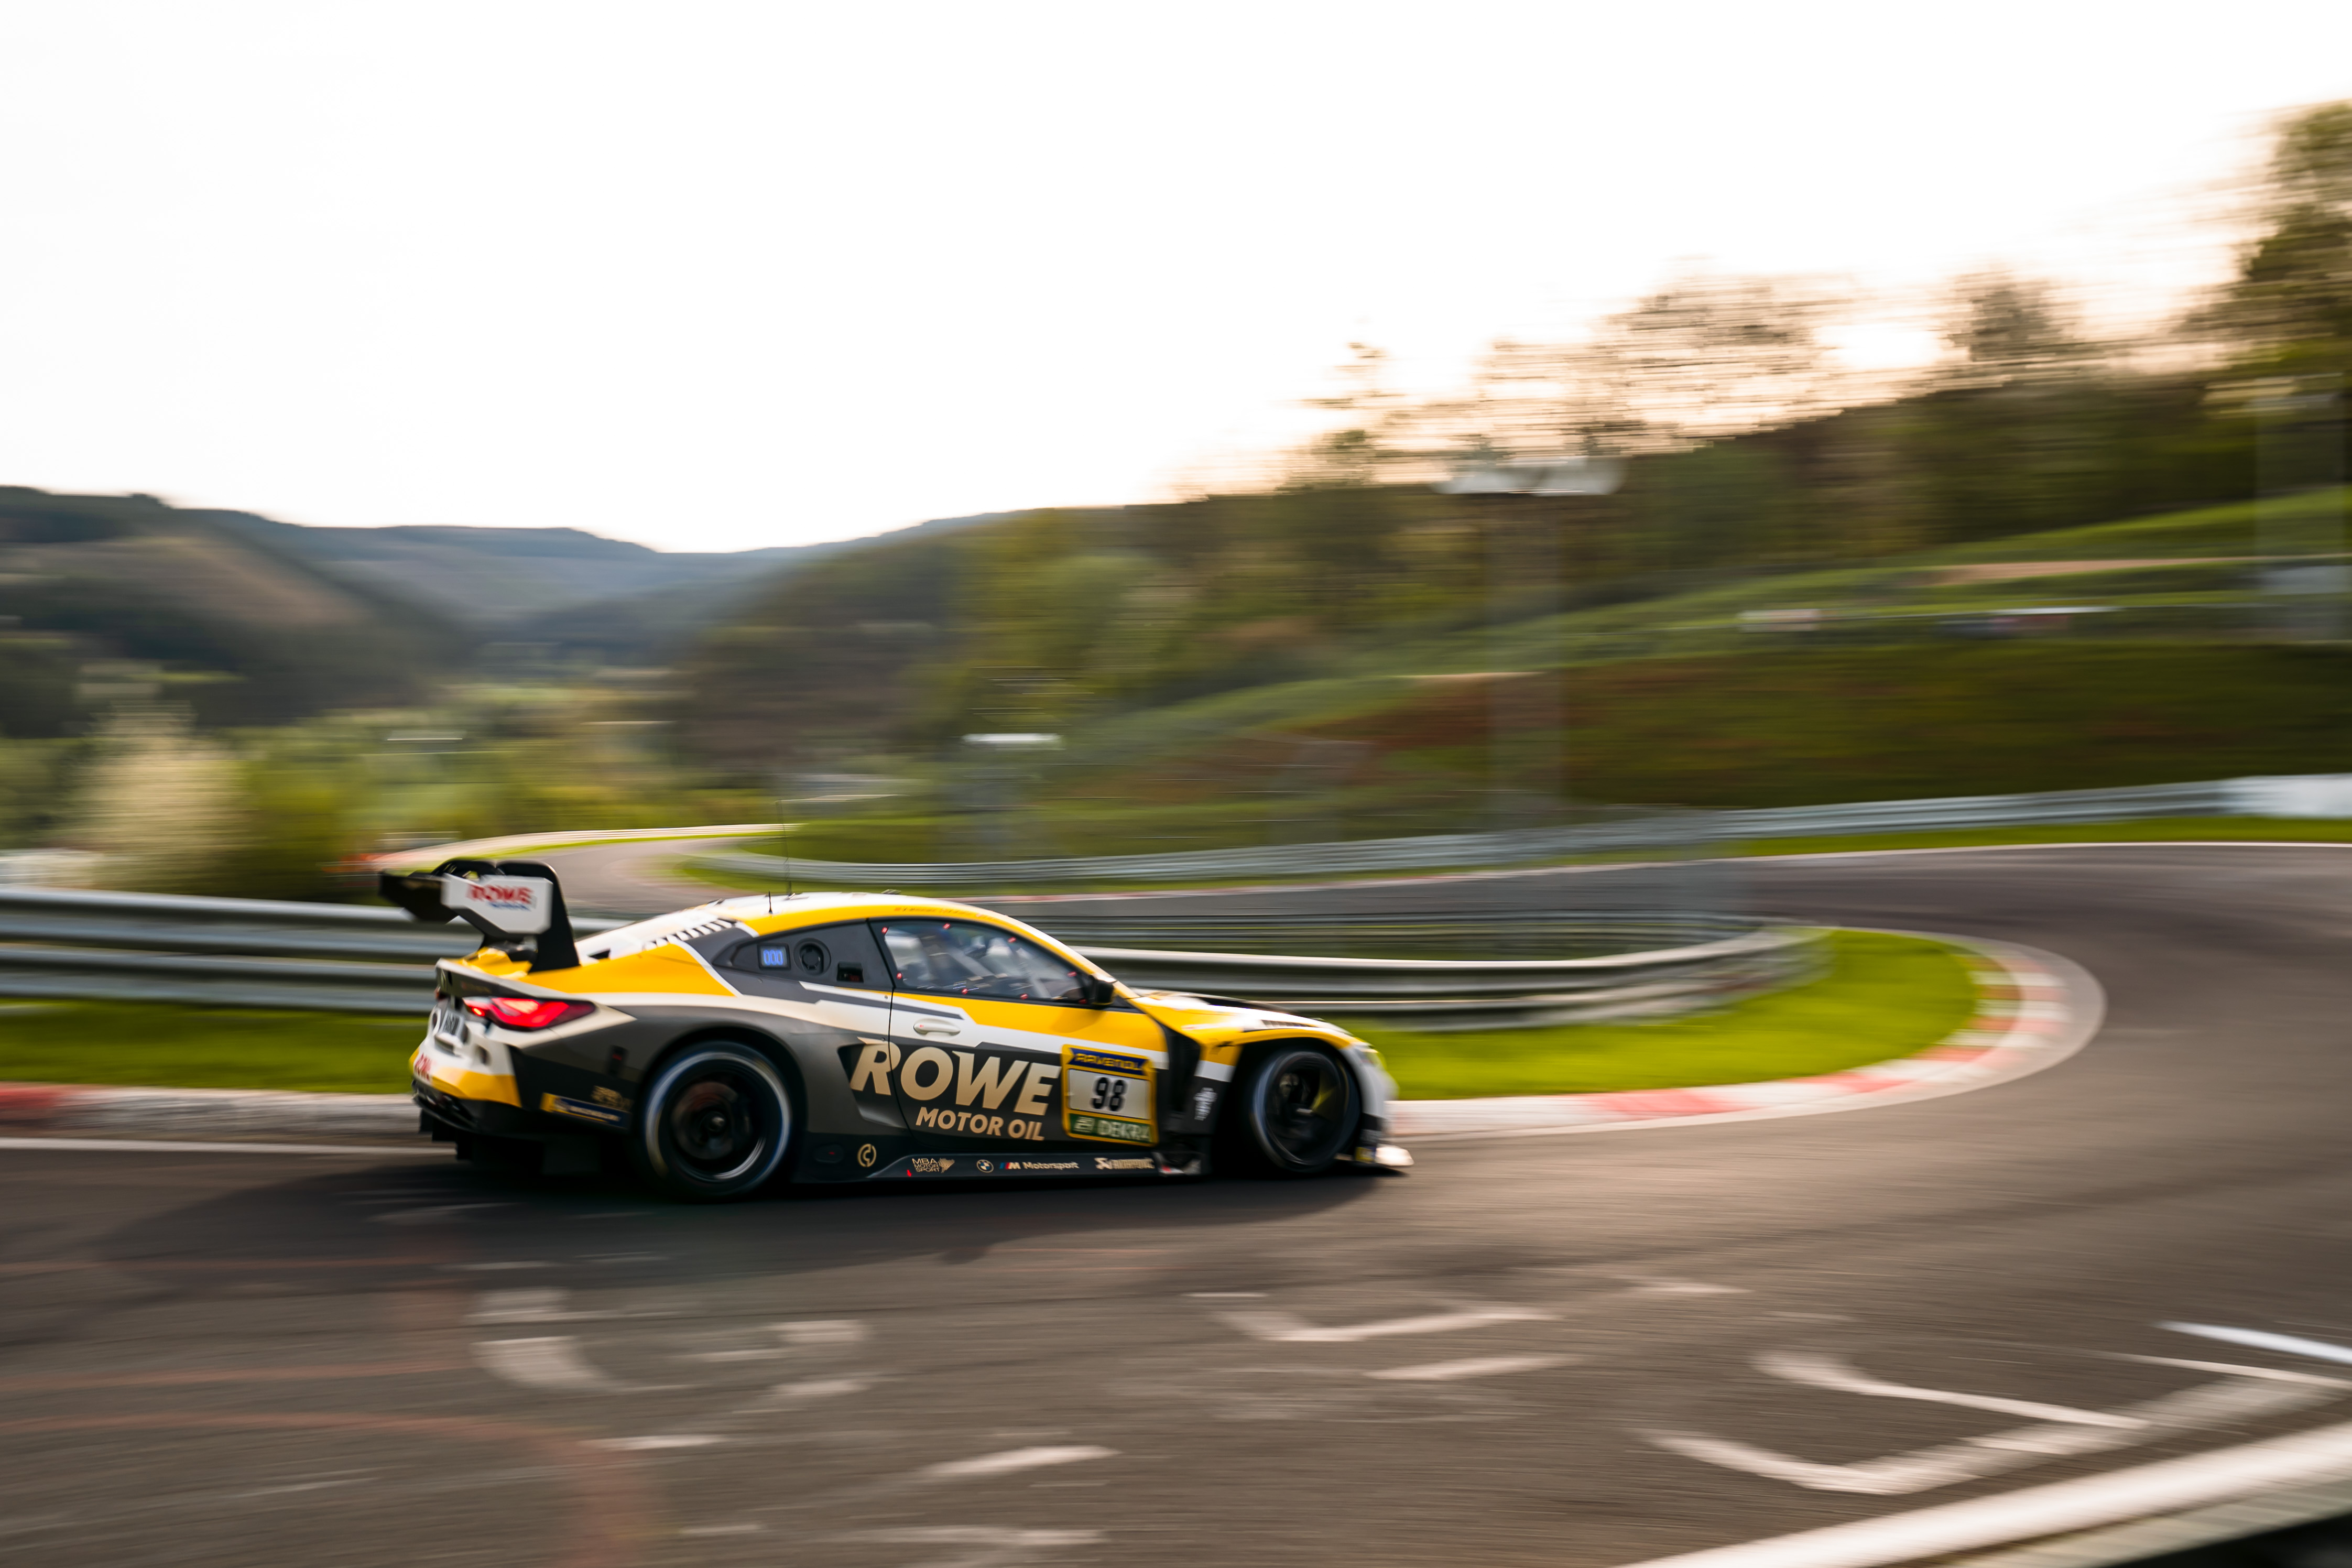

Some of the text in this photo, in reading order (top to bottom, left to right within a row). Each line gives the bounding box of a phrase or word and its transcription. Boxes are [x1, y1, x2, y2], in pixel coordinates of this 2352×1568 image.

[850, 1037, 1062, 1116] ROWE
[1090, 1077, 1127, 1112] 98
[916, 1107, 1045, 1141] MOTOR OIL
[1097, 1119, 1152, 1142] DEKRA
[1022, 1161, 1080, 1170] Motorsport
